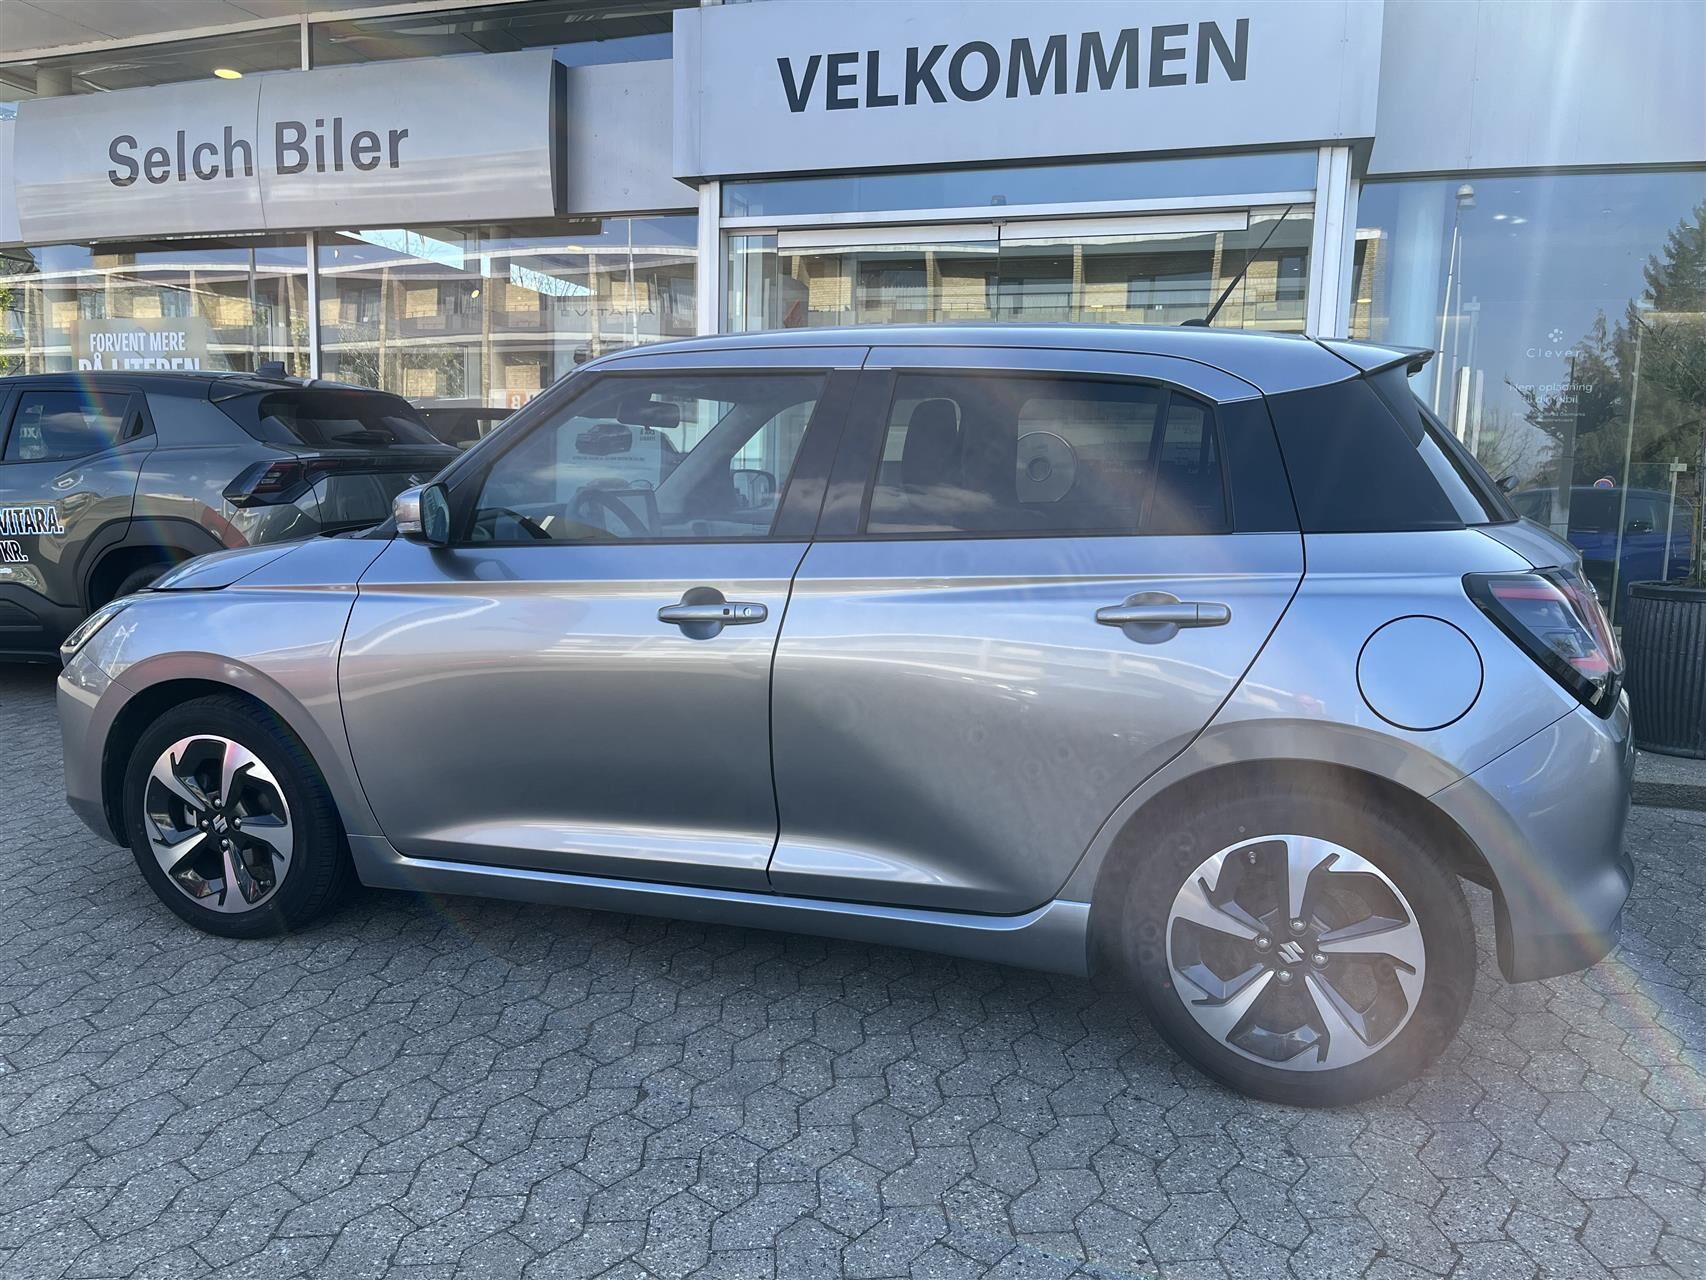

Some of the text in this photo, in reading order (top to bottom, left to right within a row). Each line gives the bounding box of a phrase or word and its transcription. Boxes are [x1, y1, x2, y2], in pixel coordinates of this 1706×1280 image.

[777, 18, 1249, 113] VELKOMMEN
[108, 117, 409, 187] Selch Biler
[90, 332, 186, 352] FORVENT MERE
[1526, 348, 1581, 358] Clever
[0, 540, 29, 562] KR.
